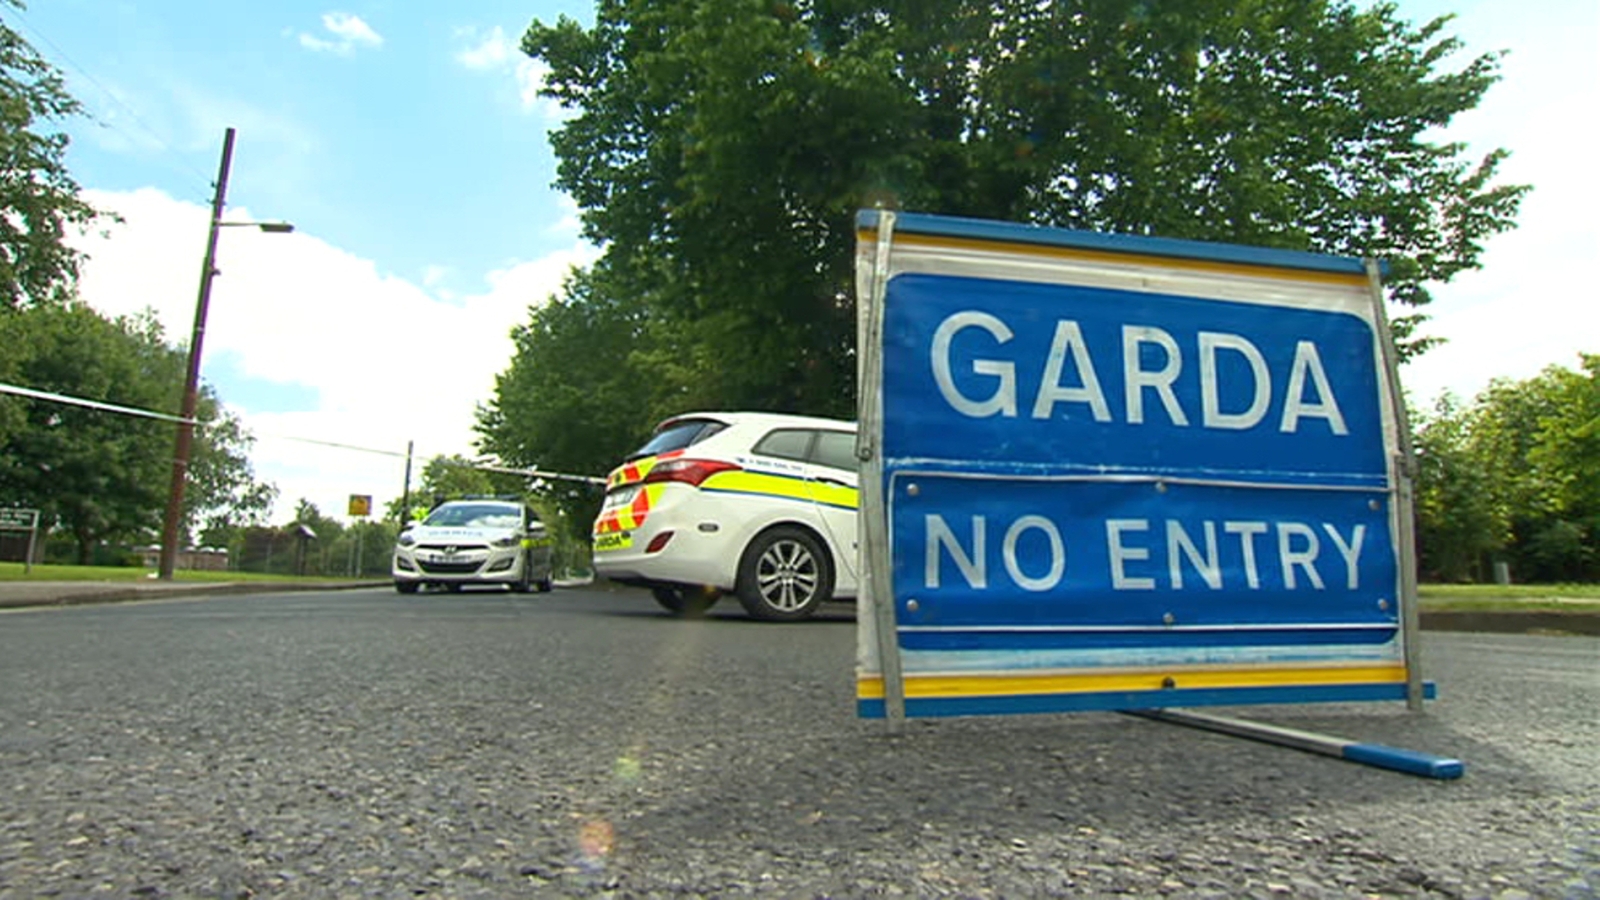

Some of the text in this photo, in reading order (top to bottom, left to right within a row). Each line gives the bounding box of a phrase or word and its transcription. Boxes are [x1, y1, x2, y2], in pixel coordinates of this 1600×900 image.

[930, 311, 1349, 435] GARDA
[925, 514, 1365, 591] NO ENTRY
